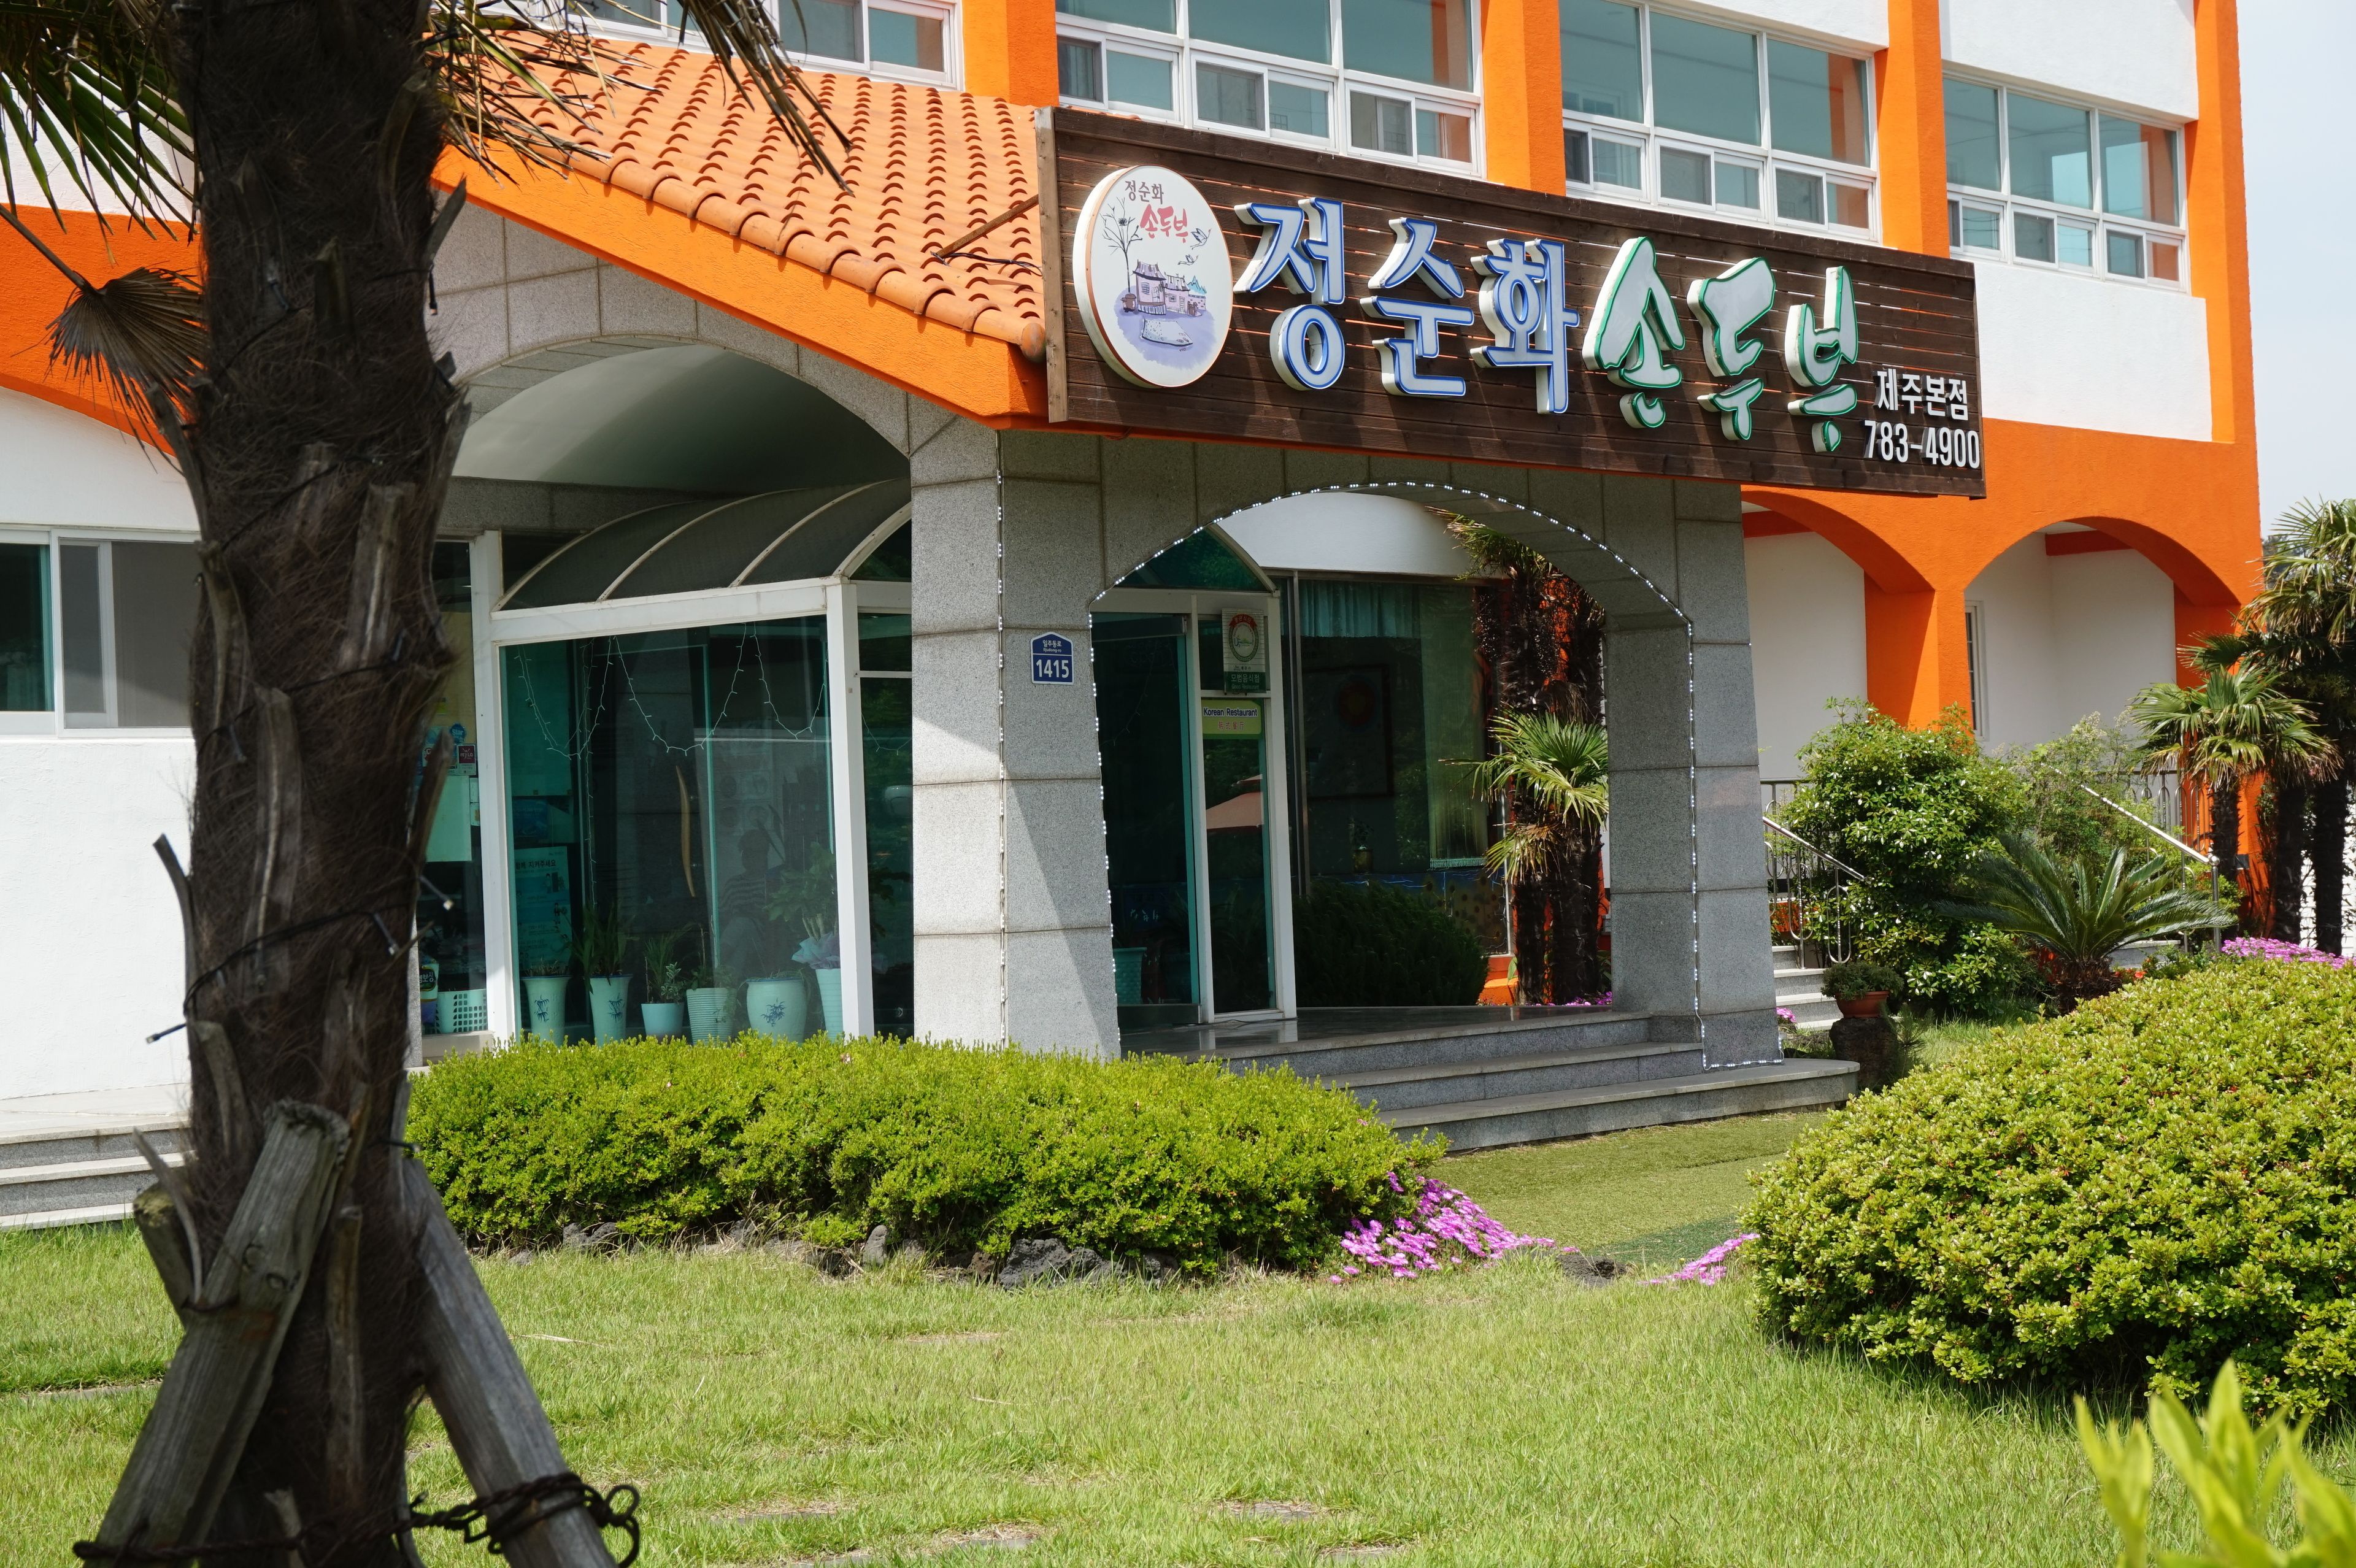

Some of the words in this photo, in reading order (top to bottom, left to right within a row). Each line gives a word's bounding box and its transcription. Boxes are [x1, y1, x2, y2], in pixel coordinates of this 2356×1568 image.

[1125, 180, 1165, 204] 정순화
[1140, 204, 1188, 244] 손두부
[1233, 198, 1580, 415] 정순화
[1582, 236, 1859, 452] 손두부
[1874, 369, 1969, 421] 제주본점
[1864, 420, 1981, 470] 783-4900
[1036, 659, 1069, 678] 1415
[1231, 674, 1260, 683] 모범음식점
[1203, 707, 1224, 717] Korean
[1226, 707, 1258, 717] Restaurant
